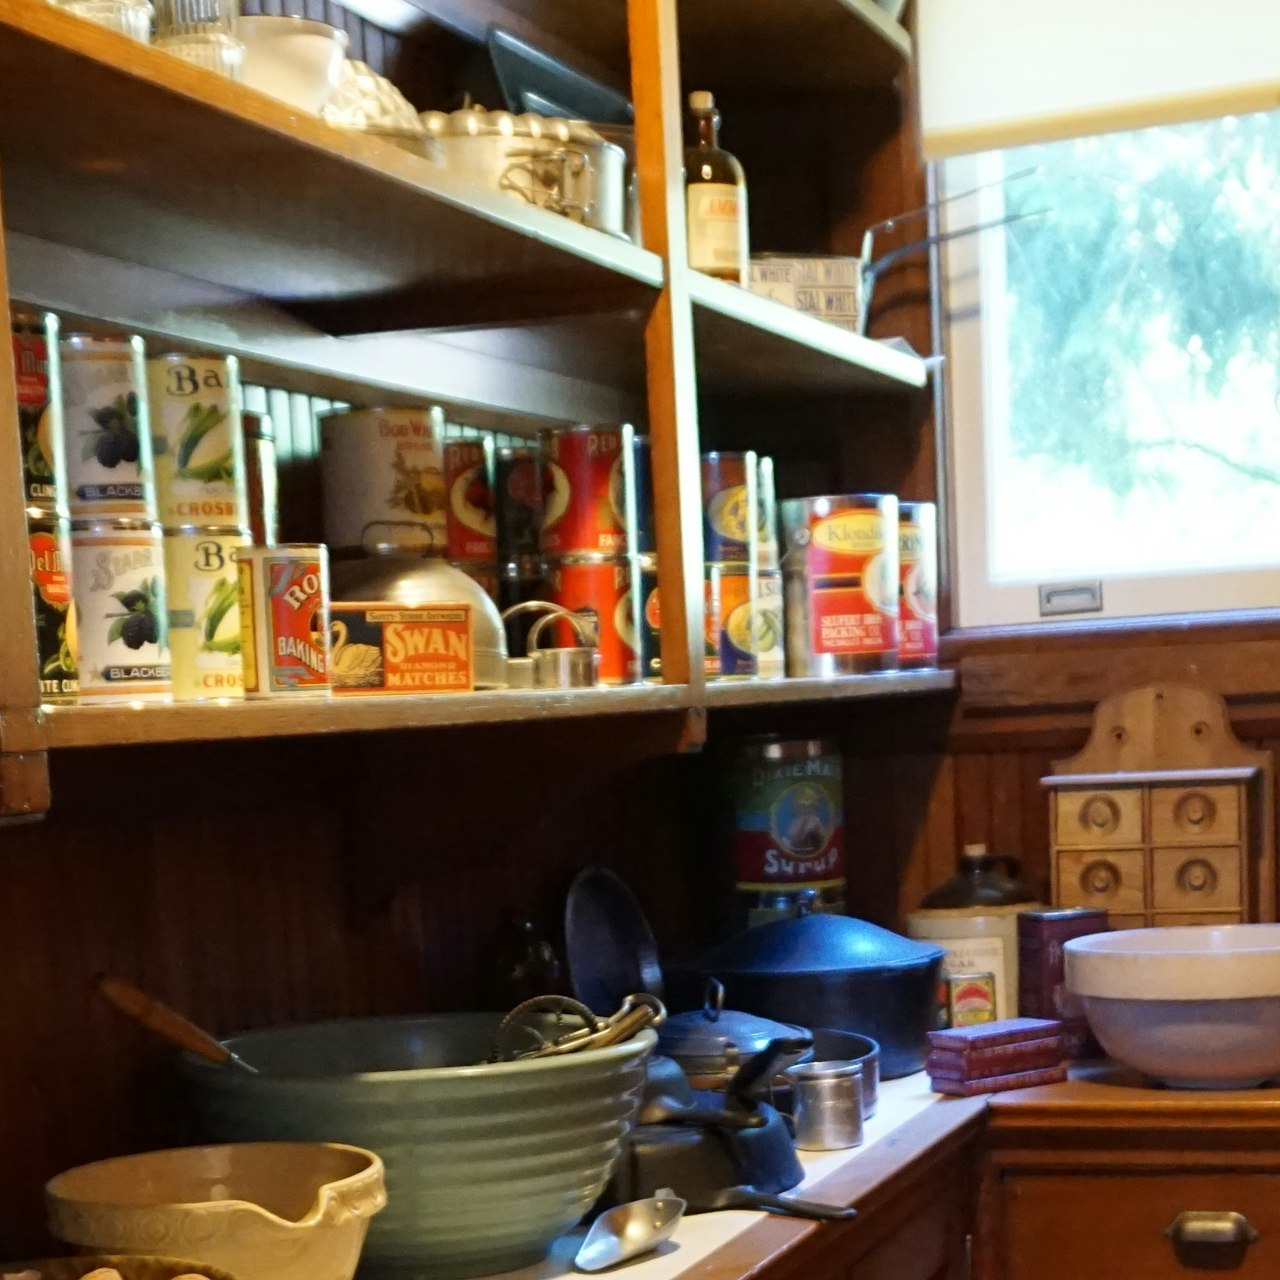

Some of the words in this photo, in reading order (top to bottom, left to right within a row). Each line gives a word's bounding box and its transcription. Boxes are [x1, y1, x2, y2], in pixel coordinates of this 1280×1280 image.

[385, 622, 468, 664] SWAN
[399, 662, 457, 671] DIAMOND
[386, 671, 468, 687] MATCHES
